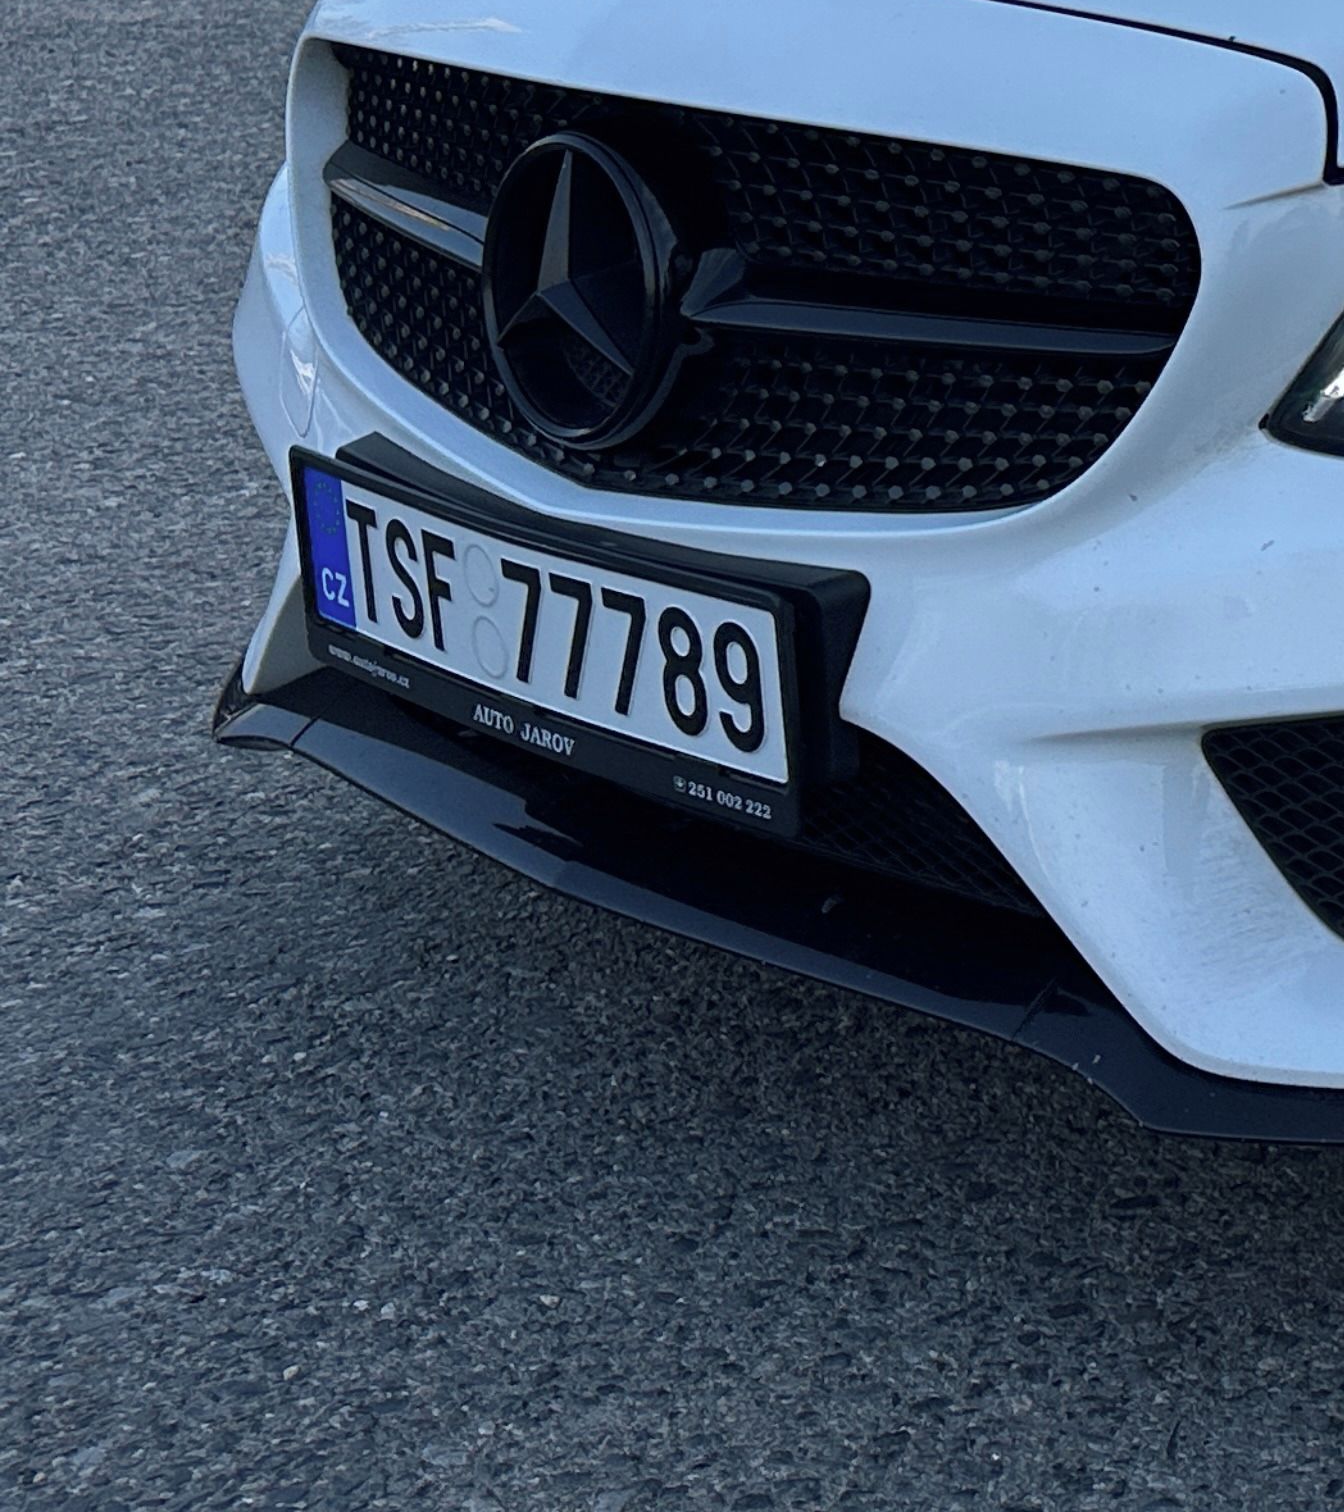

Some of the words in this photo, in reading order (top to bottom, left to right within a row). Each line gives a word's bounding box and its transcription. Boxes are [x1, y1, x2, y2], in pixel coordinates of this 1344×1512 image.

[321, 567, 350, 608] CZ
[346, 499, 456, 652] TSF
[500, 557, 766, 753] 77789
[473, 703, 514, 734] AUTO
[520, 723, 575, 756] JAROV
[688, 781, 713, 801] 251
[716, 790, 743, 810] 002
[745, 799, 772, 820] 222
